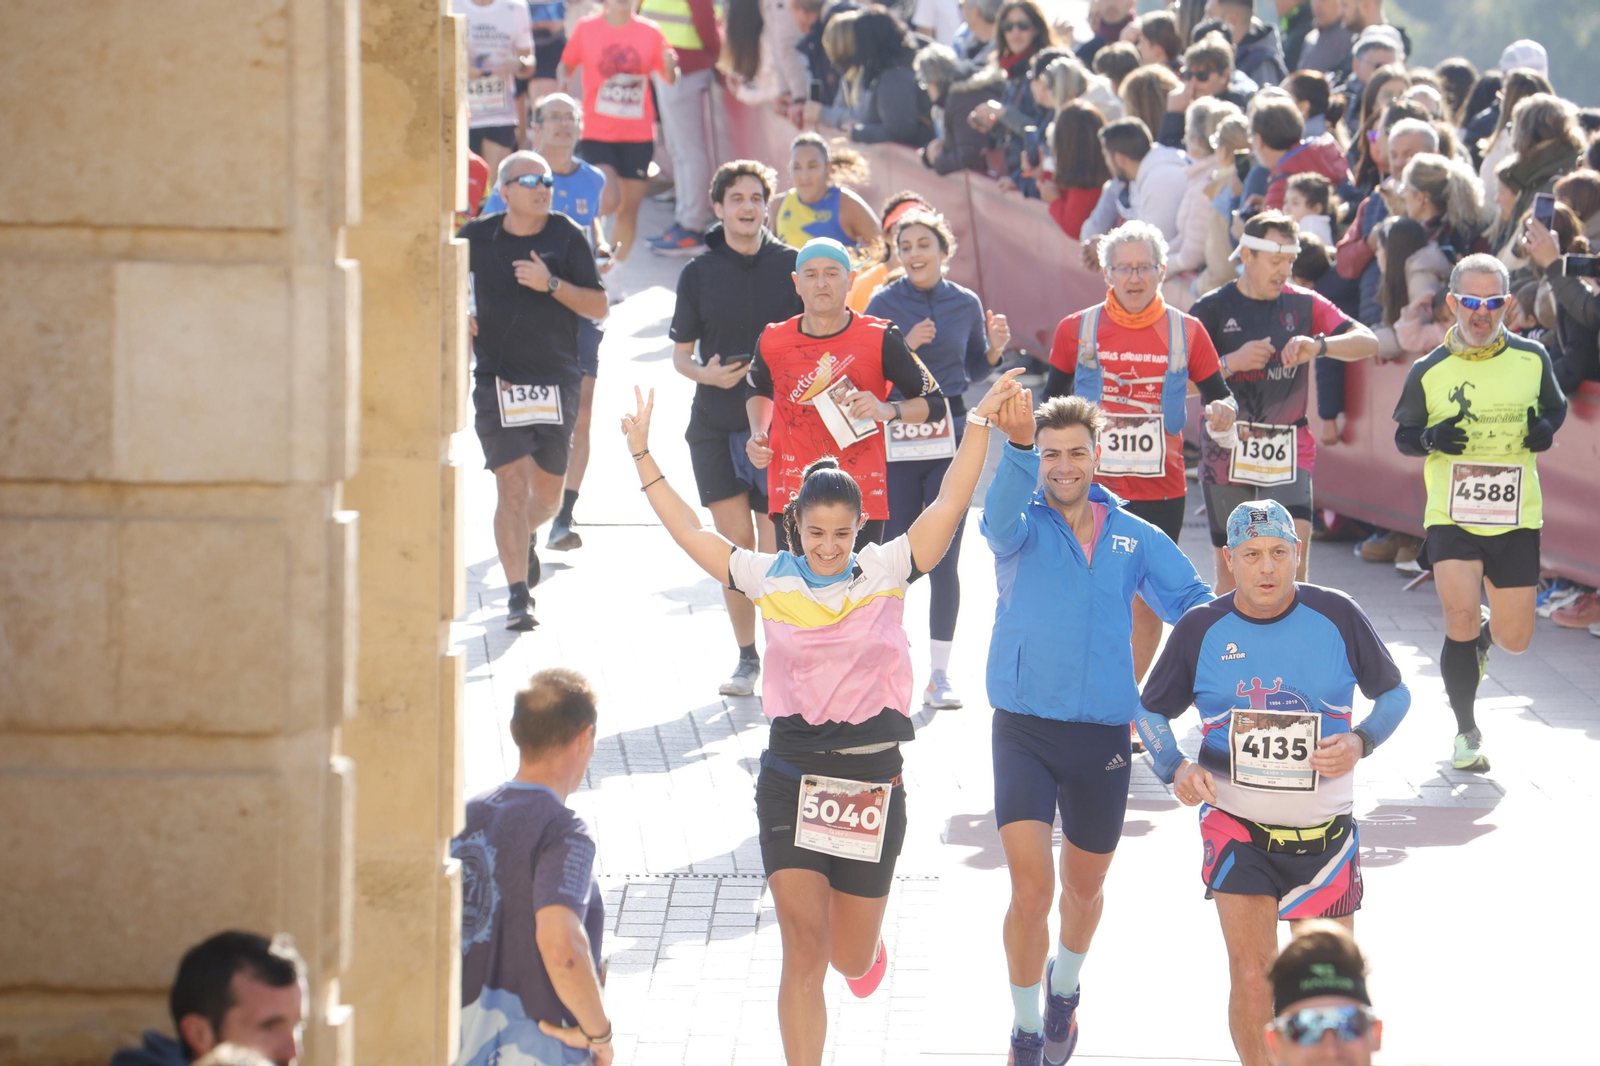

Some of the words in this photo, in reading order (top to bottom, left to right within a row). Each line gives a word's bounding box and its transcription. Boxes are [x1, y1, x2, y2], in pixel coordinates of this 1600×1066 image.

[787, 355, 837, 403] verticalia
[508, 385, 549, 403] 1369
[1108, 433, 1154, 452] 3110
[1242, 441, 1286, 461] 1306
[1455, 482, 1516, 502] 4588
[1221, 652, 1246, 661] VIATOR
[1242, 735, 1308, 761] 4135
[1105, 761, 1127, 771] adidas
[802, 795, 881, 830] 5040
